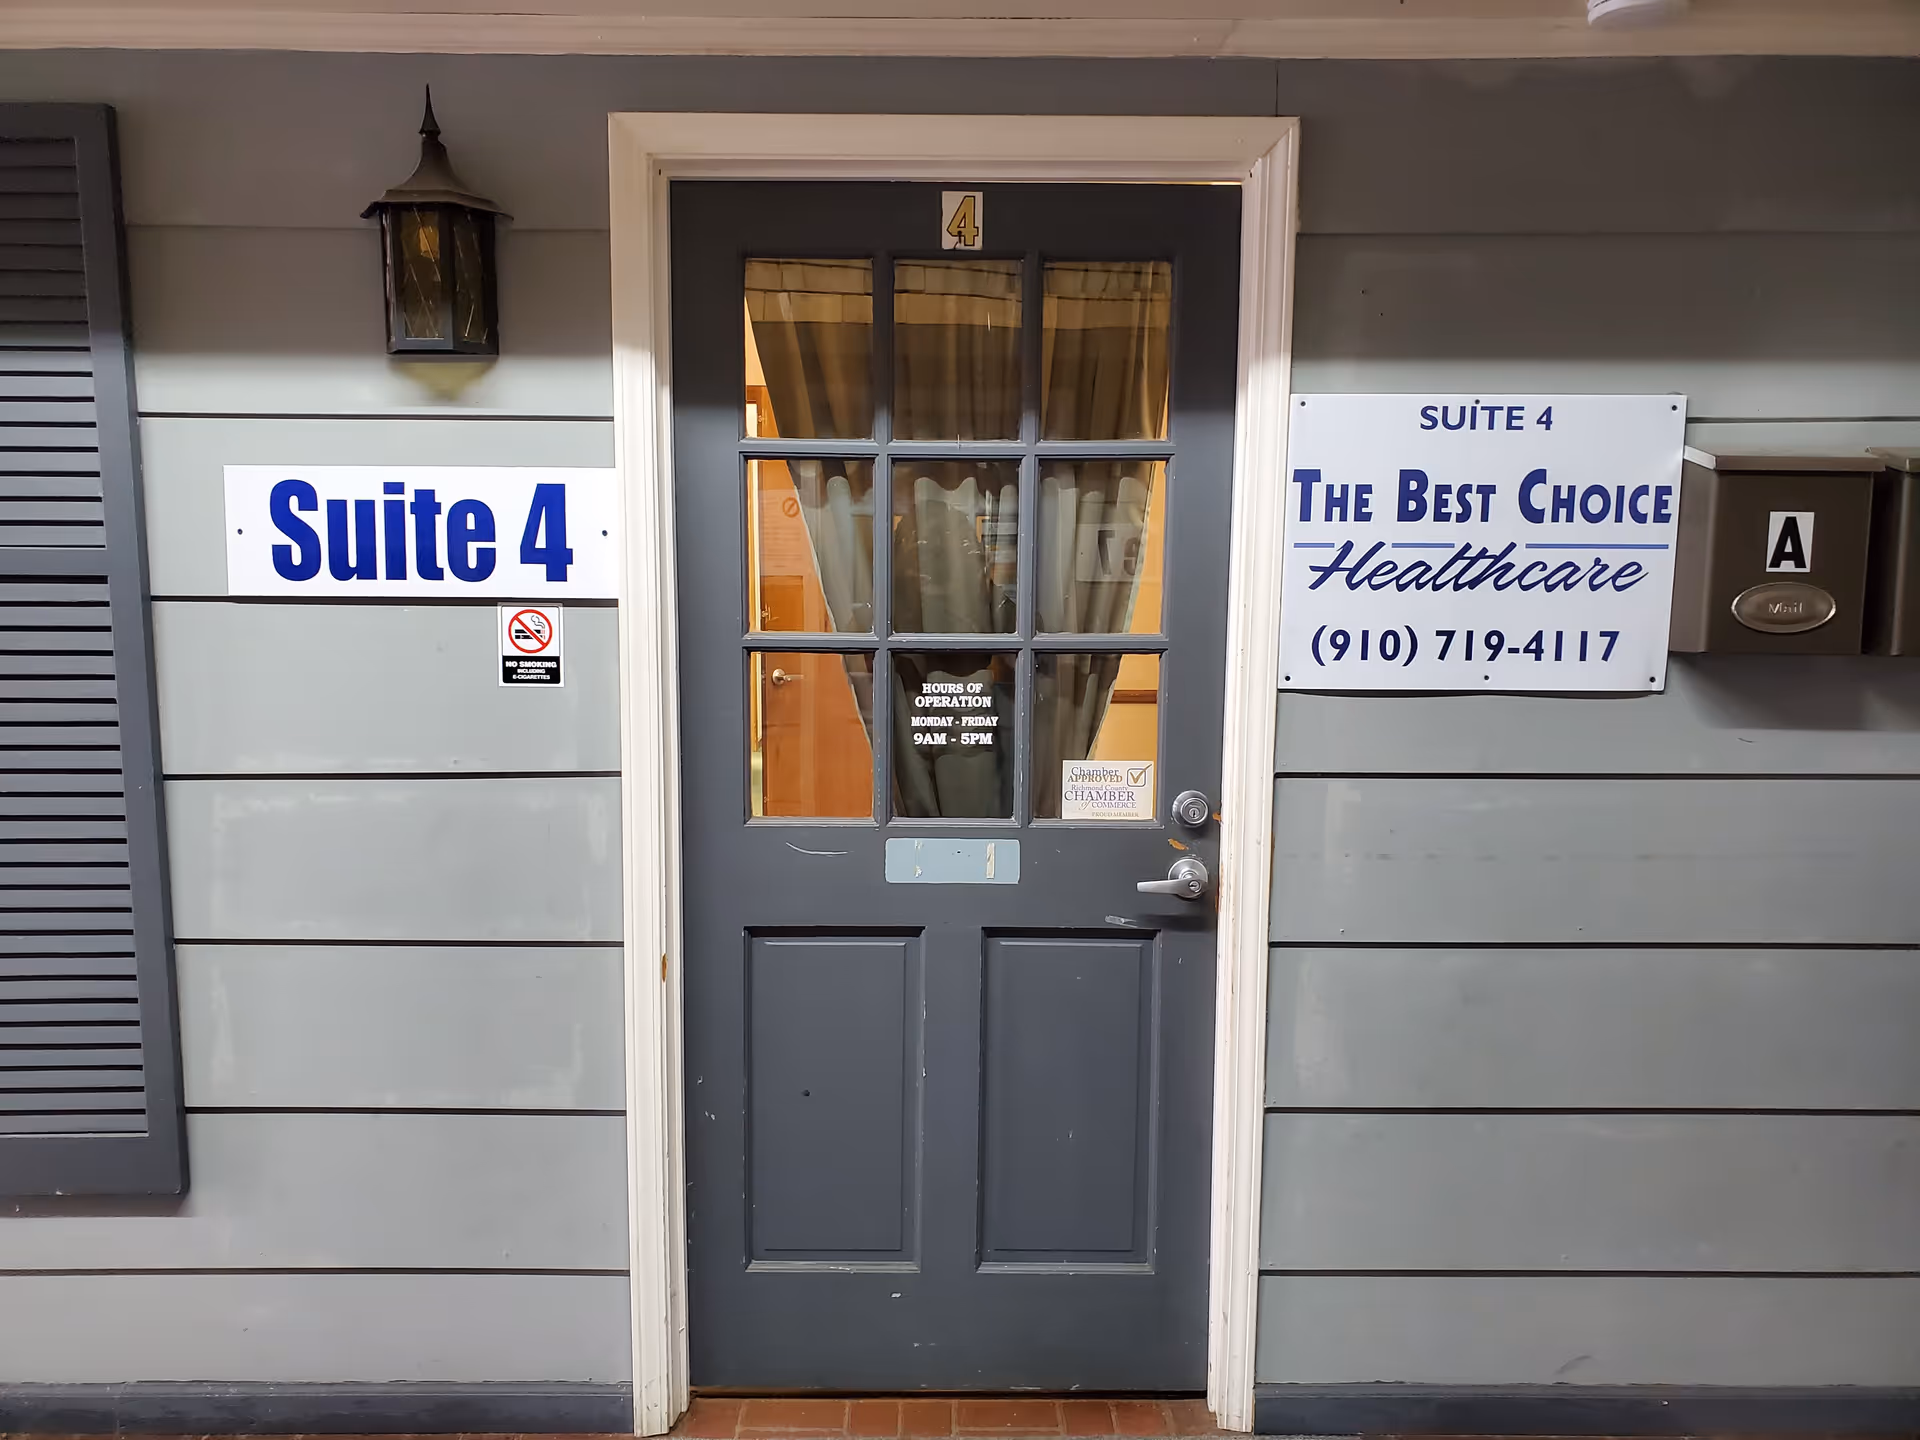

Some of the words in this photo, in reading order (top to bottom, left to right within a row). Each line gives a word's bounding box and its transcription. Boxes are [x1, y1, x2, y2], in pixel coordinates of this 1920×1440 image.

[947, 195, 979, 246] 4
[1420, 405, 1524, 431] SUITE
[1536, 406, 1553, 431] 4
[270, 479, 496, 582] Suite
[520, 483, 573, 582] 4
[1768, 517, 1806, 568] A
[1307, 540, 1649, 592] Healthcare
[1769, 602, 1803, 614] Mail
[1311, 625, 1418, 666] (910)
[1435, 630, 1620, 662] 719-4117
[922, 683, 964, 693] HOURS
[967, 683, 983, 693] OF
[915, 696, 991, 707] OPERATION
[911, 716, 954, 726] MONDAY
[962, 716, 998, 726] FRIDAY
[914, 733, 947, 744] 9AM
[961, 733, 993, 744] 5PM
[1071, 767, 1119, 775] Chamber
[1065, 791, 1135, 801] CHAMBER
[1079, 800, 1091, 810] of
